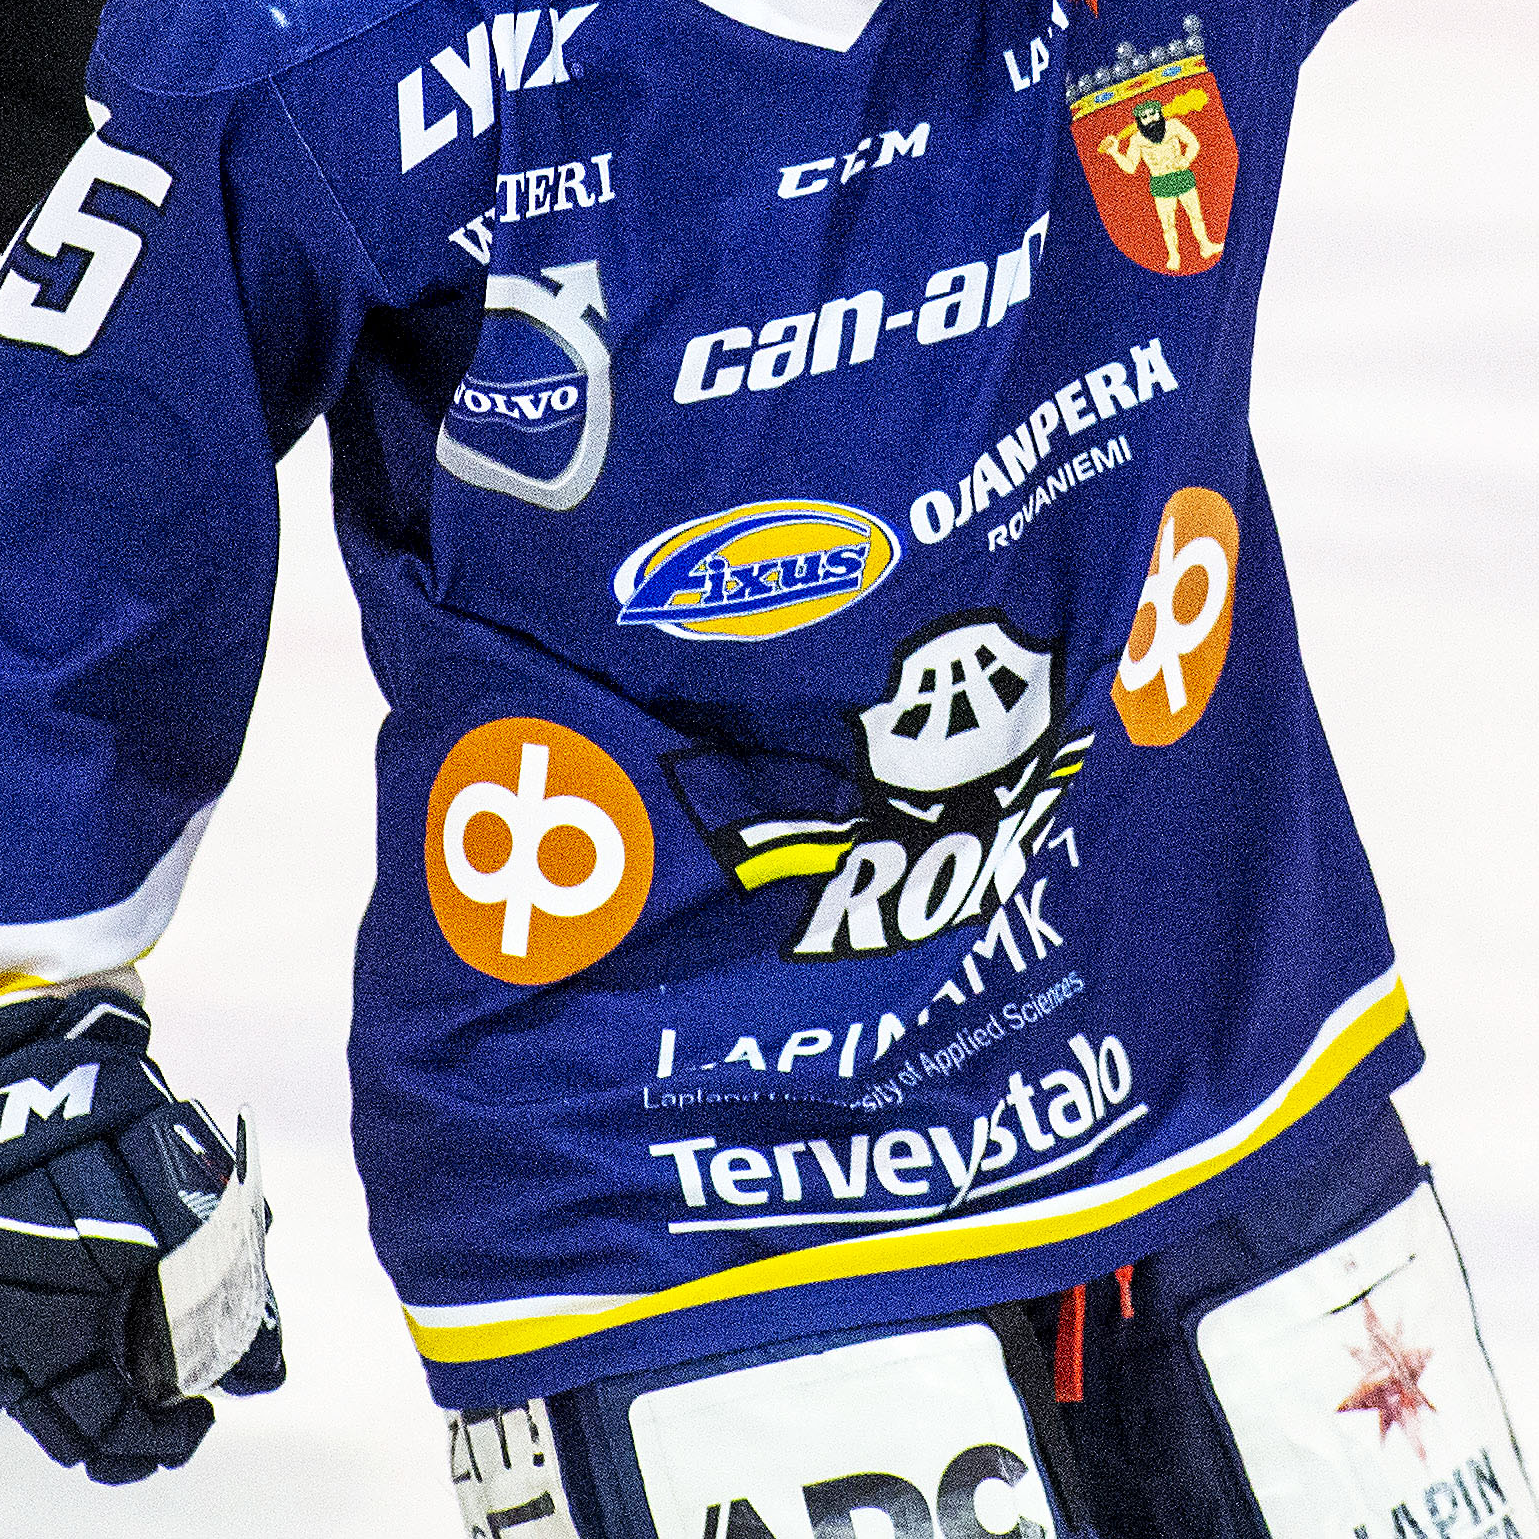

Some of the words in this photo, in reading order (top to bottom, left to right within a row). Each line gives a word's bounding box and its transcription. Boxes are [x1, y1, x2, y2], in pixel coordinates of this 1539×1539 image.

[988, 434, 1133, 552] ROVANIEMI
[919, 1013, 1006, 1077] Applied
[649, 1032, 1132, 1209] Terveystalo
